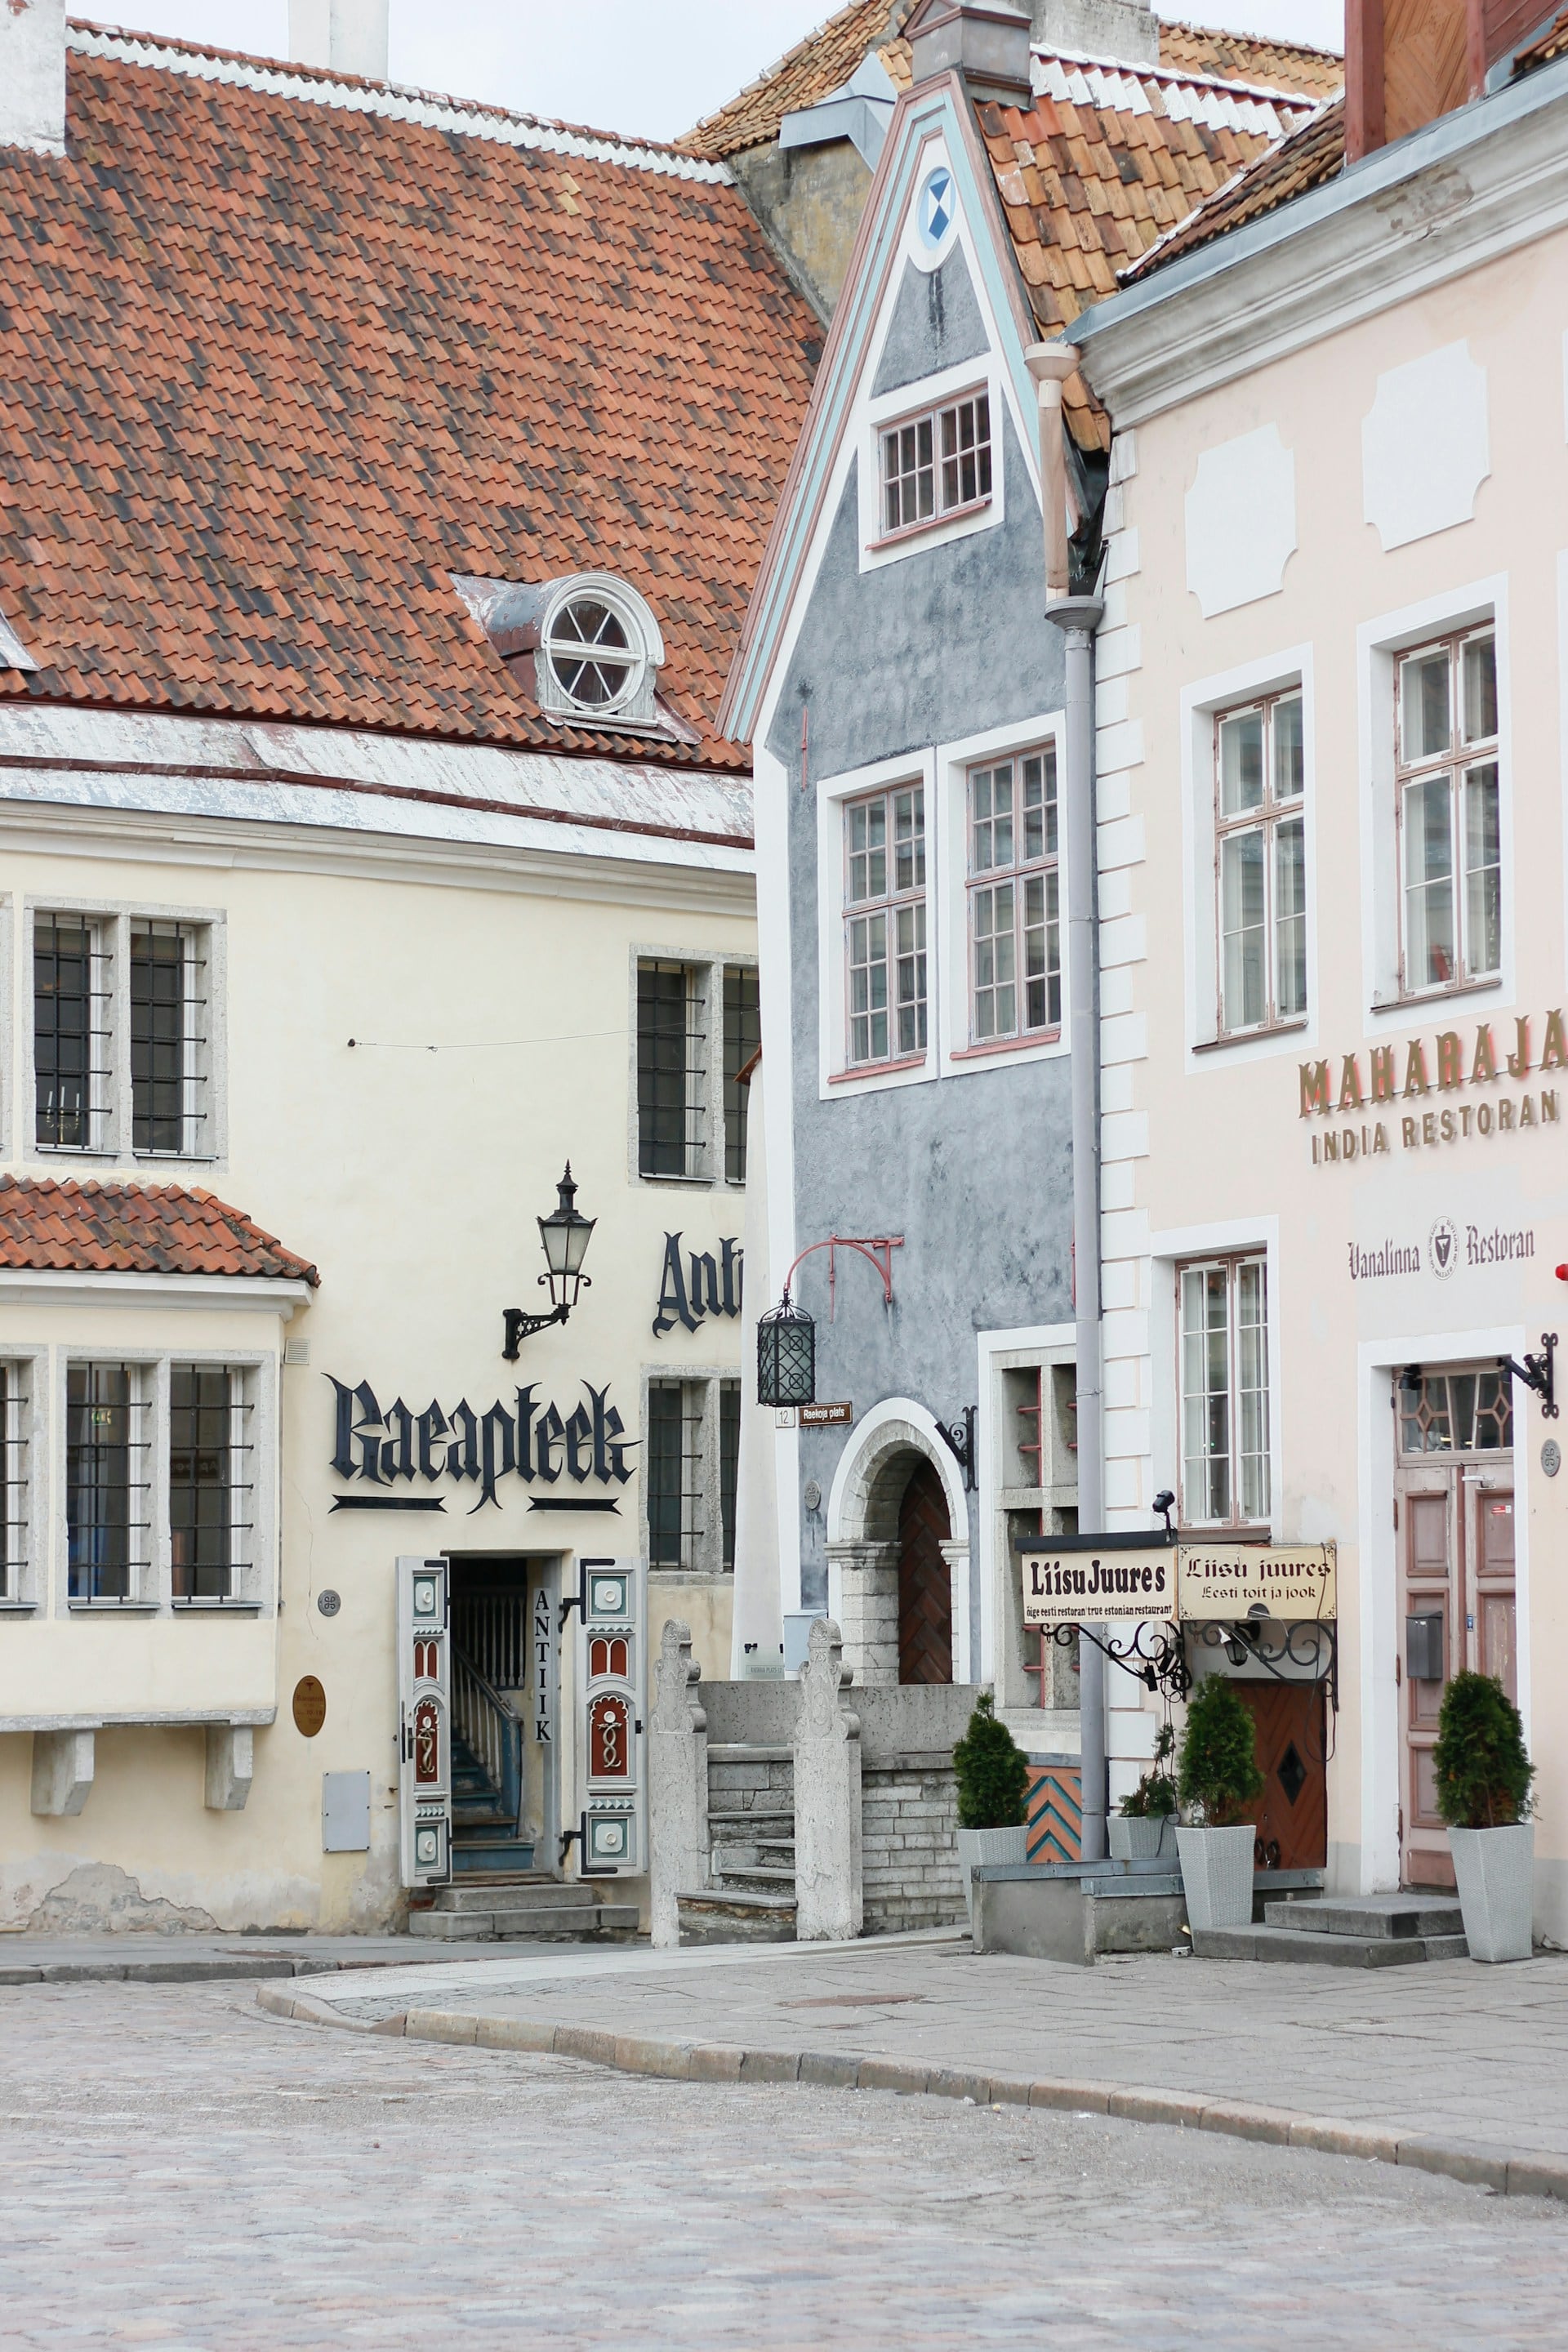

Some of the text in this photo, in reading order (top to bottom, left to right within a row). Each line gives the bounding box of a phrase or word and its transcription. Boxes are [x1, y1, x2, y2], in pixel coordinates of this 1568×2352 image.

[1297, 1008, 1568, 1119] MAHARAJA
[1312, 1089, 1556, 1165] INDIA RESTORAN
[1466, 1225, 1535, 1266] Restoran
[779, 1410, 789, 1424] 12
[803, 1406, 845, 1421] Raekoja plats
[320, 1372, 644, 1516] Raeapteek
[1186, 1558, 1331, 1582] Liisu juures
[1202, 1586, 1316, 1600] Eesti toit ja jook
[1040, 1606, 1057, 1617] eesti
[1058, 1606, 1086, 1617] restoran
[1104, 1605, 1134, 1615] estonian
[1134, 1604, 1173, 1615] restaurant
[533, 1590, 551, 1742] ANTIIK
